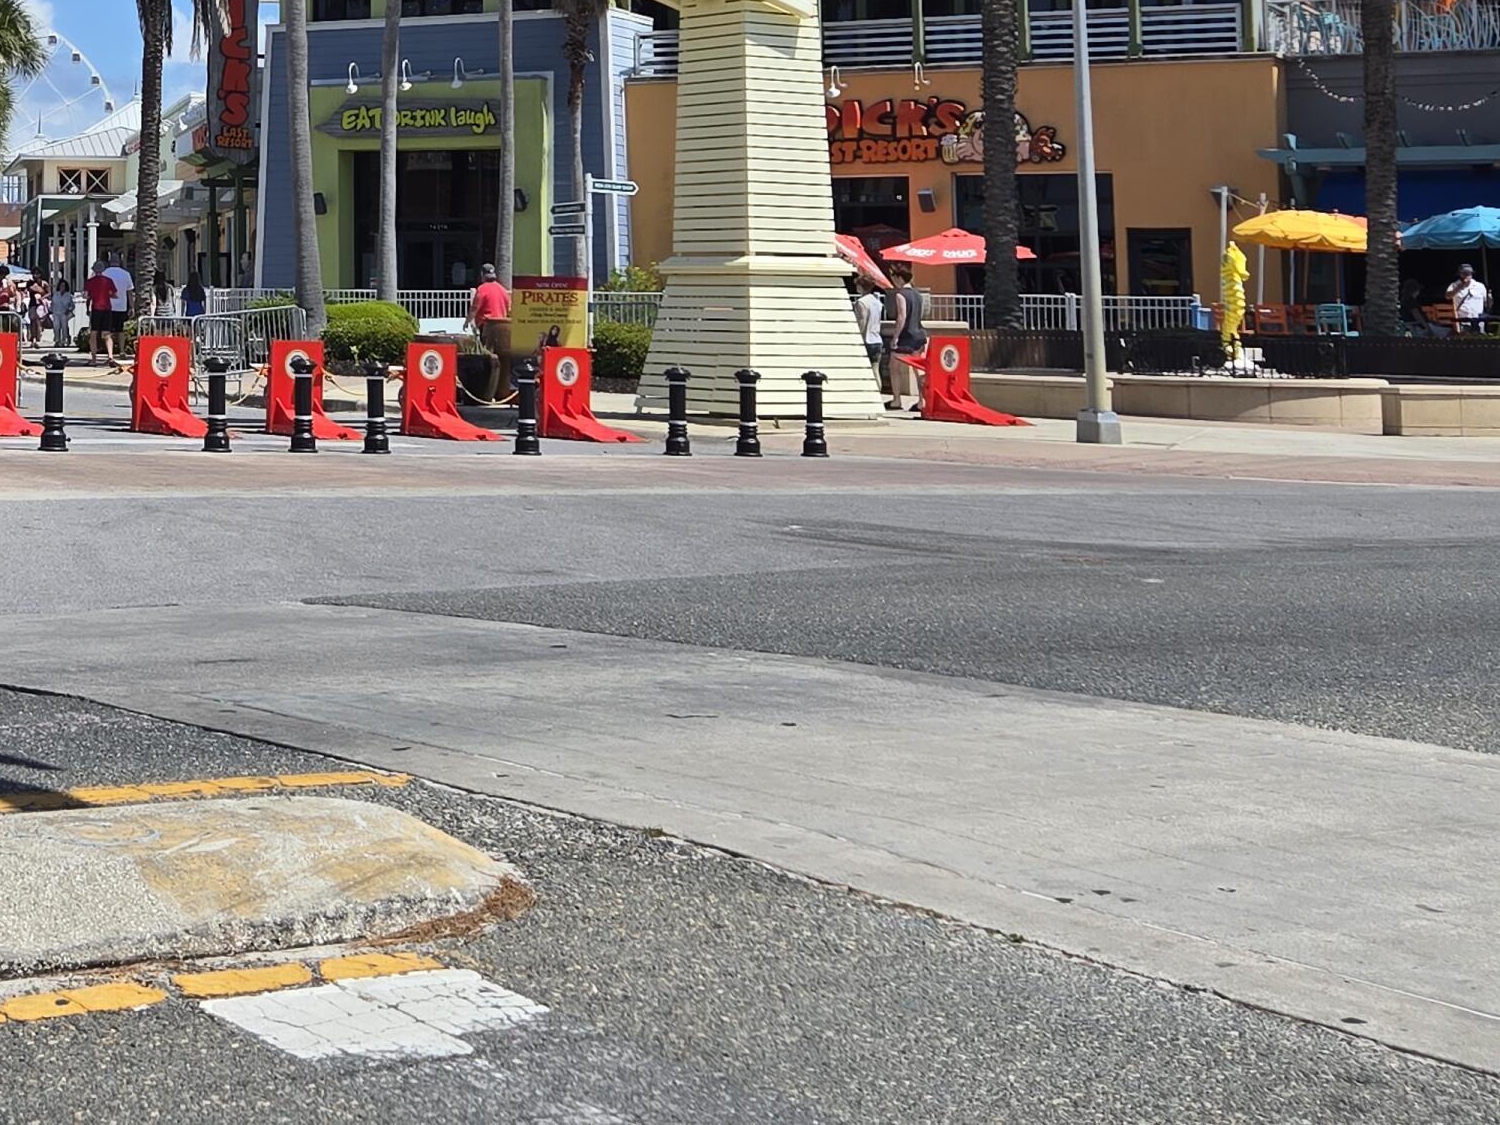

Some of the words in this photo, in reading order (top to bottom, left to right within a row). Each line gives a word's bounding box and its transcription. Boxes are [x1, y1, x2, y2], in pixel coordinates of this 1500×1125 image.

[341, 106, 383, 132] EAT
[450, 102, 496, 135] laugh
[222, 126, 250, 139] LAST
[215, 135, 254, 149] RESORT
[830, 140, 857, 164] ST
[860, 138, 939, 164] RESORT
[520, 290, 579, 306] PIRATES
